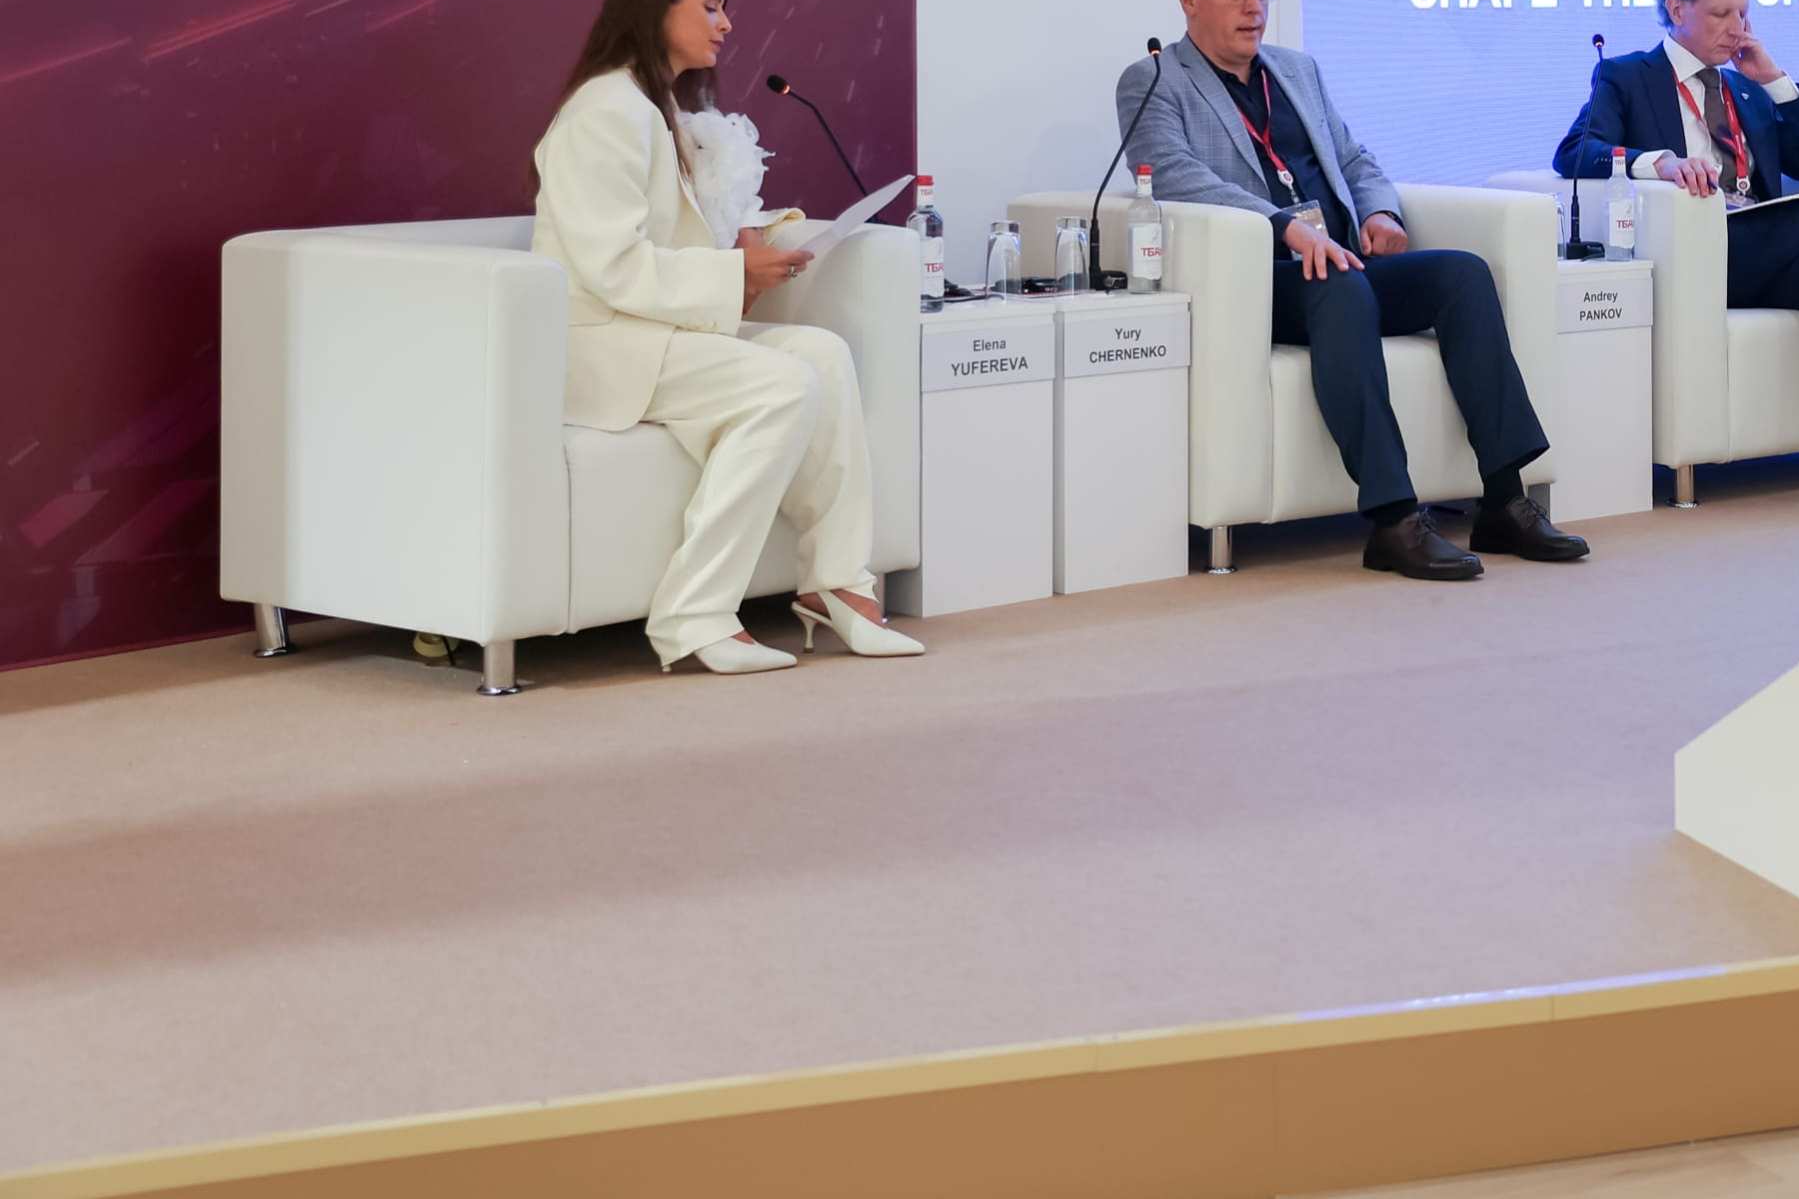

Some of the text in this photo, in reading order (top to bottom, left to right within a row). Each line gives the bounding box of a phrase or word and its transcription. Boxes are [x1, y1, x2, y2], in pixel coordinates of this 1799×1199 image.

[1583, 290, 1619, 304] Andrey
[1579, 308, 1623, 322] PANKOV
[1114, 327, 1142, 342] Yury
[972, 337, 1007, 353] Elena
[1089, 344, 1167, 365] CHERNENKO
[951, 356, 1029, 377] YUFEREVA
